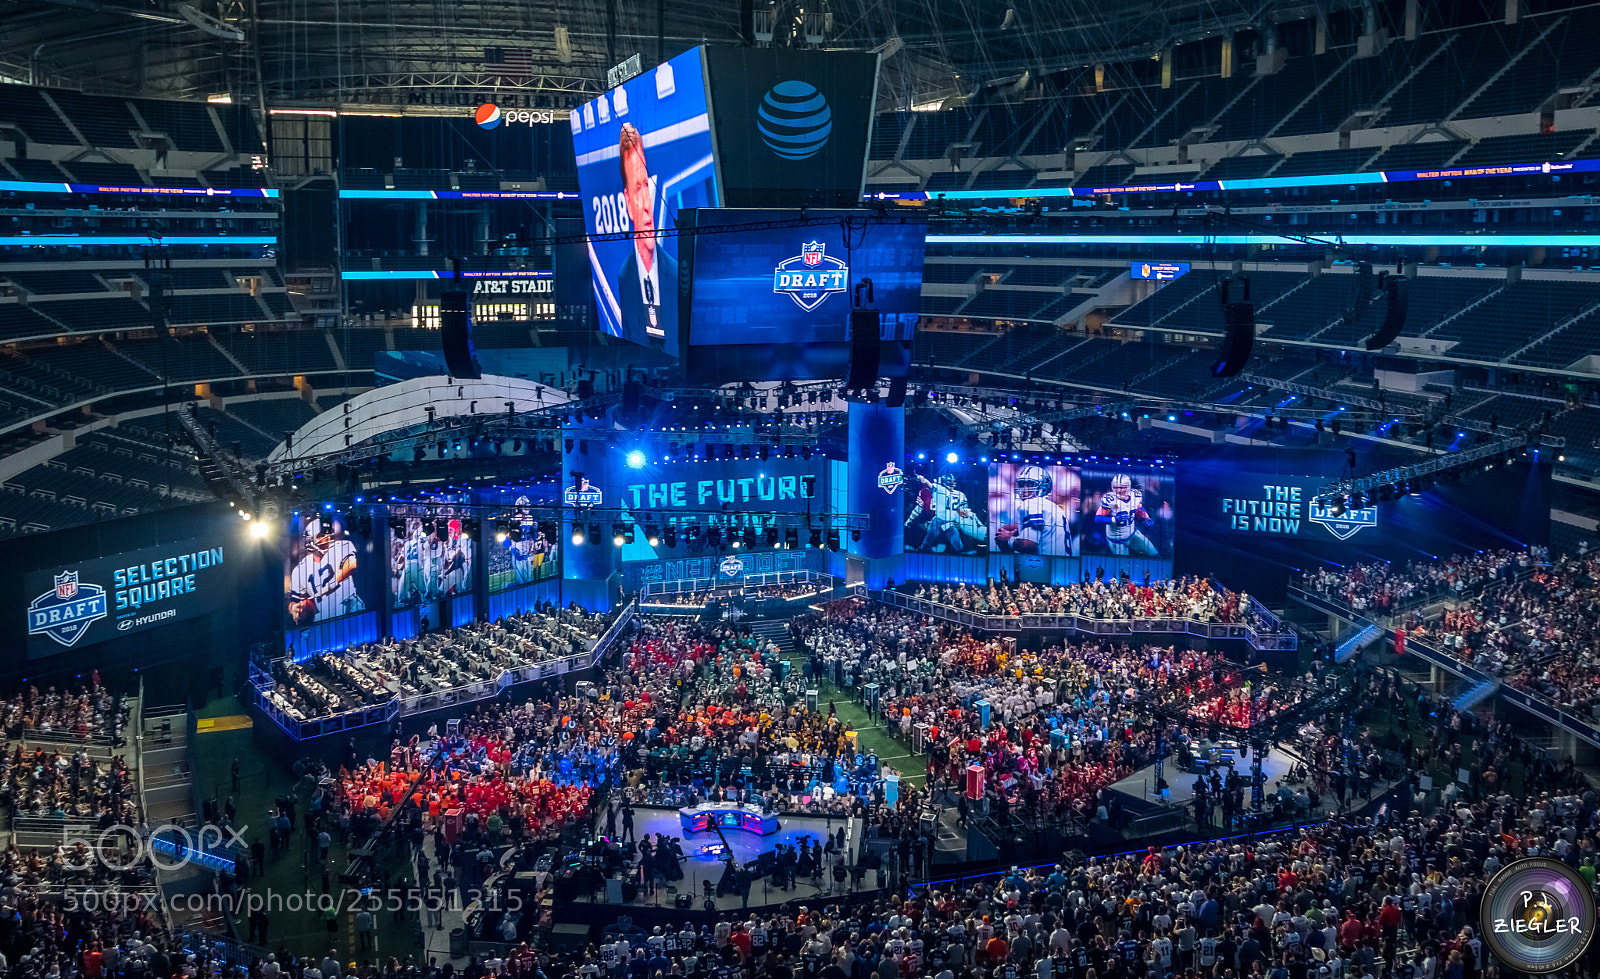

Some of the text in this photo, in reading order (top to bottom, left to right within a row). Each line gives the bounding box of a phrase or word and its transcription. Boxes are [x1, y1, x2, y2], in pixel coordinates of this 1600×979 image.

[505, 110, 554, 127] pepsi
[593, 192, 629, 234] 2018
[804, 253, 821, 265] NFL
[473, 280, 554, 294] AT&T STADI
[779, 274, 843, 287] DRAFT
[880, 475, 902, 484] DRAFT
[628, 475, 816, 509] THE FUTURE
[1263, 485, 1301, 502] THE
[1222, 499, 1301, 518] FUTURE
[1231, 515, 1300, 534] IS NOW
[114, 547, 223, 589] SELECTION
[641, 552, 806, 585] #NFLRAFT
[308, 564, 335, 594] 12
[58, 582, 75, 596] NFL
[116, 574, 196, 610] SQUARE
[35, 600, 100, 626] DRAFT
[136, 609, 176, 626] HYUNDAI
[61, 625, 77, 633] 2018
